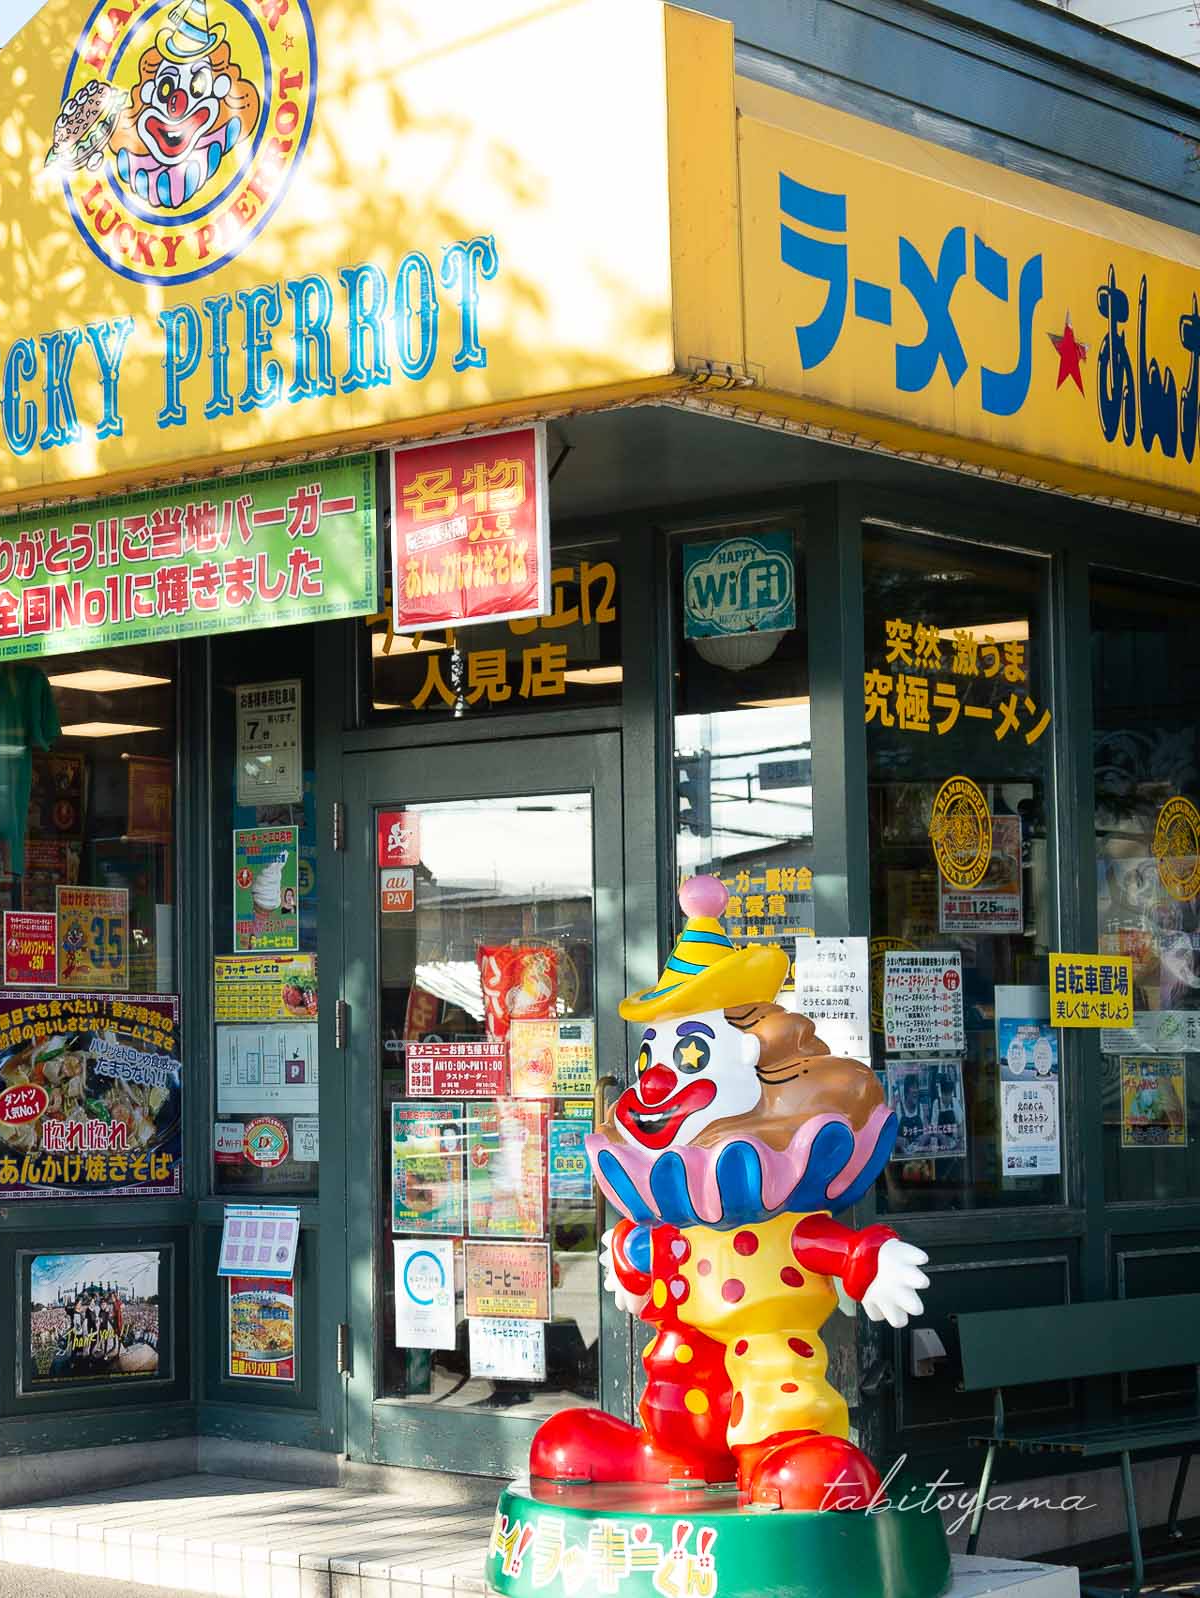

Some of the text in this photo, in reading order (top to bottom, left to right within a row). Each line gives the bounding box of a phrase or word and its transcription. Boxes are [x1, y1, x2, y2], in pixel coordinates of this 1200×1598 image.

[80, 66, 304, 269] LUCKY PIERROT
[779, 171, 1043, 416] ラーメン
[158, 234, 499, 428] PIERROT
[403, 459, 526, 521] 名物
[469, 517, 514, 542] 人見
[717, 548, 757, 564] HAPPY
[885, 618, 1026, 684] 突然 激うま
[411, 642, 568, 711] 人見店
[863, 669, 1053, 746] 究極ラーメン
[247, 721, 259, 740] 7
[938, 782, 987, 819] HAMBURGER
[386, 877, 408, 888] au
[387, 892, 407, 904] PAY
[225, 965, 279, 975] ラッキーピエロ
[1055, 964, 1128, 996] 自転車置場
[1056, 1000, 1130, 1020] 美しく並べましょう
[445, 1072, 488, 1081] ラストオーダー
[552, 1082, 591, 1092] ラッキーピエロ
[5, 1089, 36, 1106] ダントツ
[4, 1103, 40, 1121] 人気No.1
[43, 1119, 129, 1151] 惚れ惚れ
[0, 1153, 173, 1185] あんかけ焼きそば
[486, 1269, 520, 1287] コーヒー
